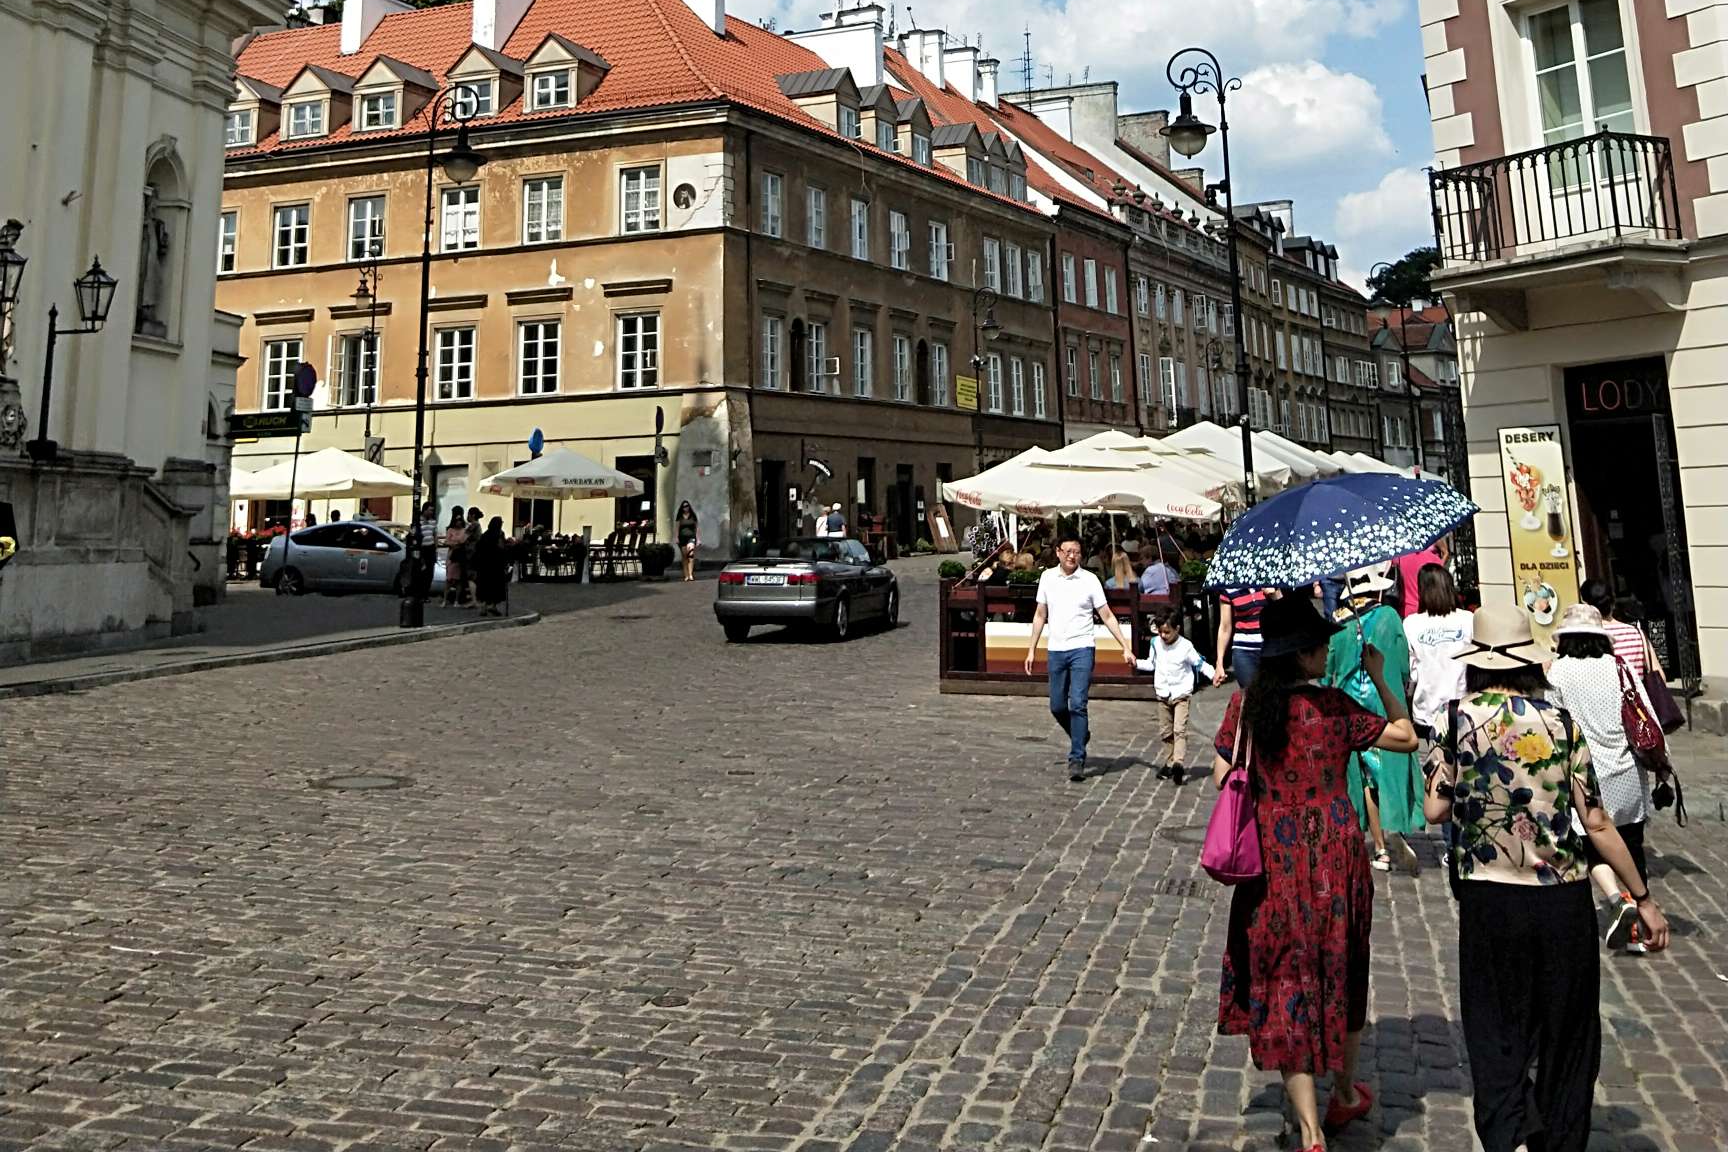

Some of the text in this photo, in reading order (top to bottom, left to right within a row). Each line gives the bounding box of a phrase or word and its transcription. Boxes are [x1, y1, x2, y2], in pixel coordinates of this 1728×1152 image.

[1581, 378, 1662, 411] LODY
[1504, 431, 1555, 445] DESERY
[1519, 561, 1570, 571] DLA DZIECI
